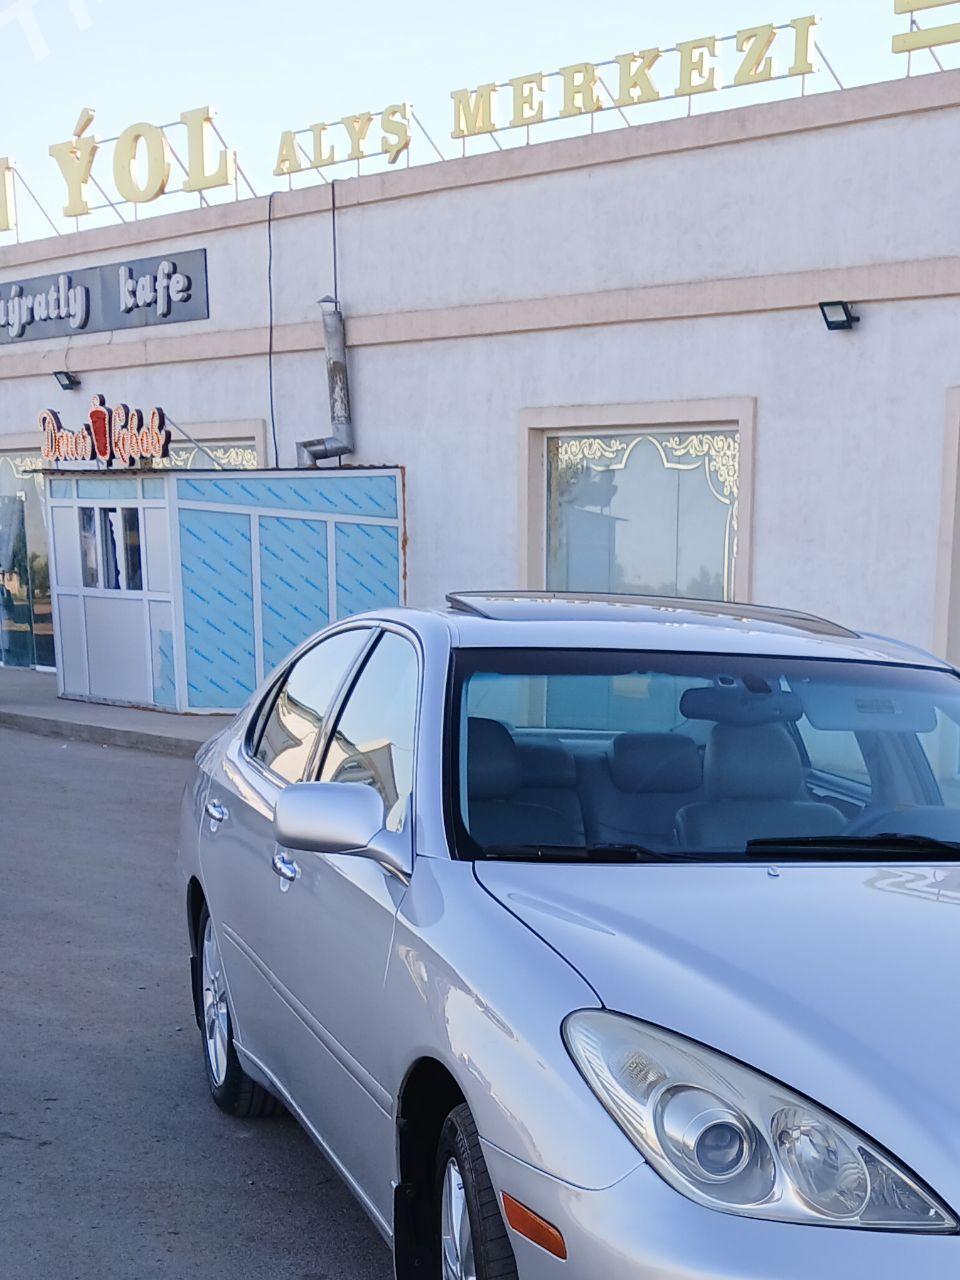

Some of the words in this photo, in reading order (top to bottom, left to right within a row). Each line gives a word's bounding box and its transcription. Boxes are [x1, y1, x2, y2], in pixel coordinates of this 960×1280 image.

[273, 103, 411, 176] ALYŞ
[450, 14, 817, 139] MERKEZI
[119, 260, 191, 318] kafe
